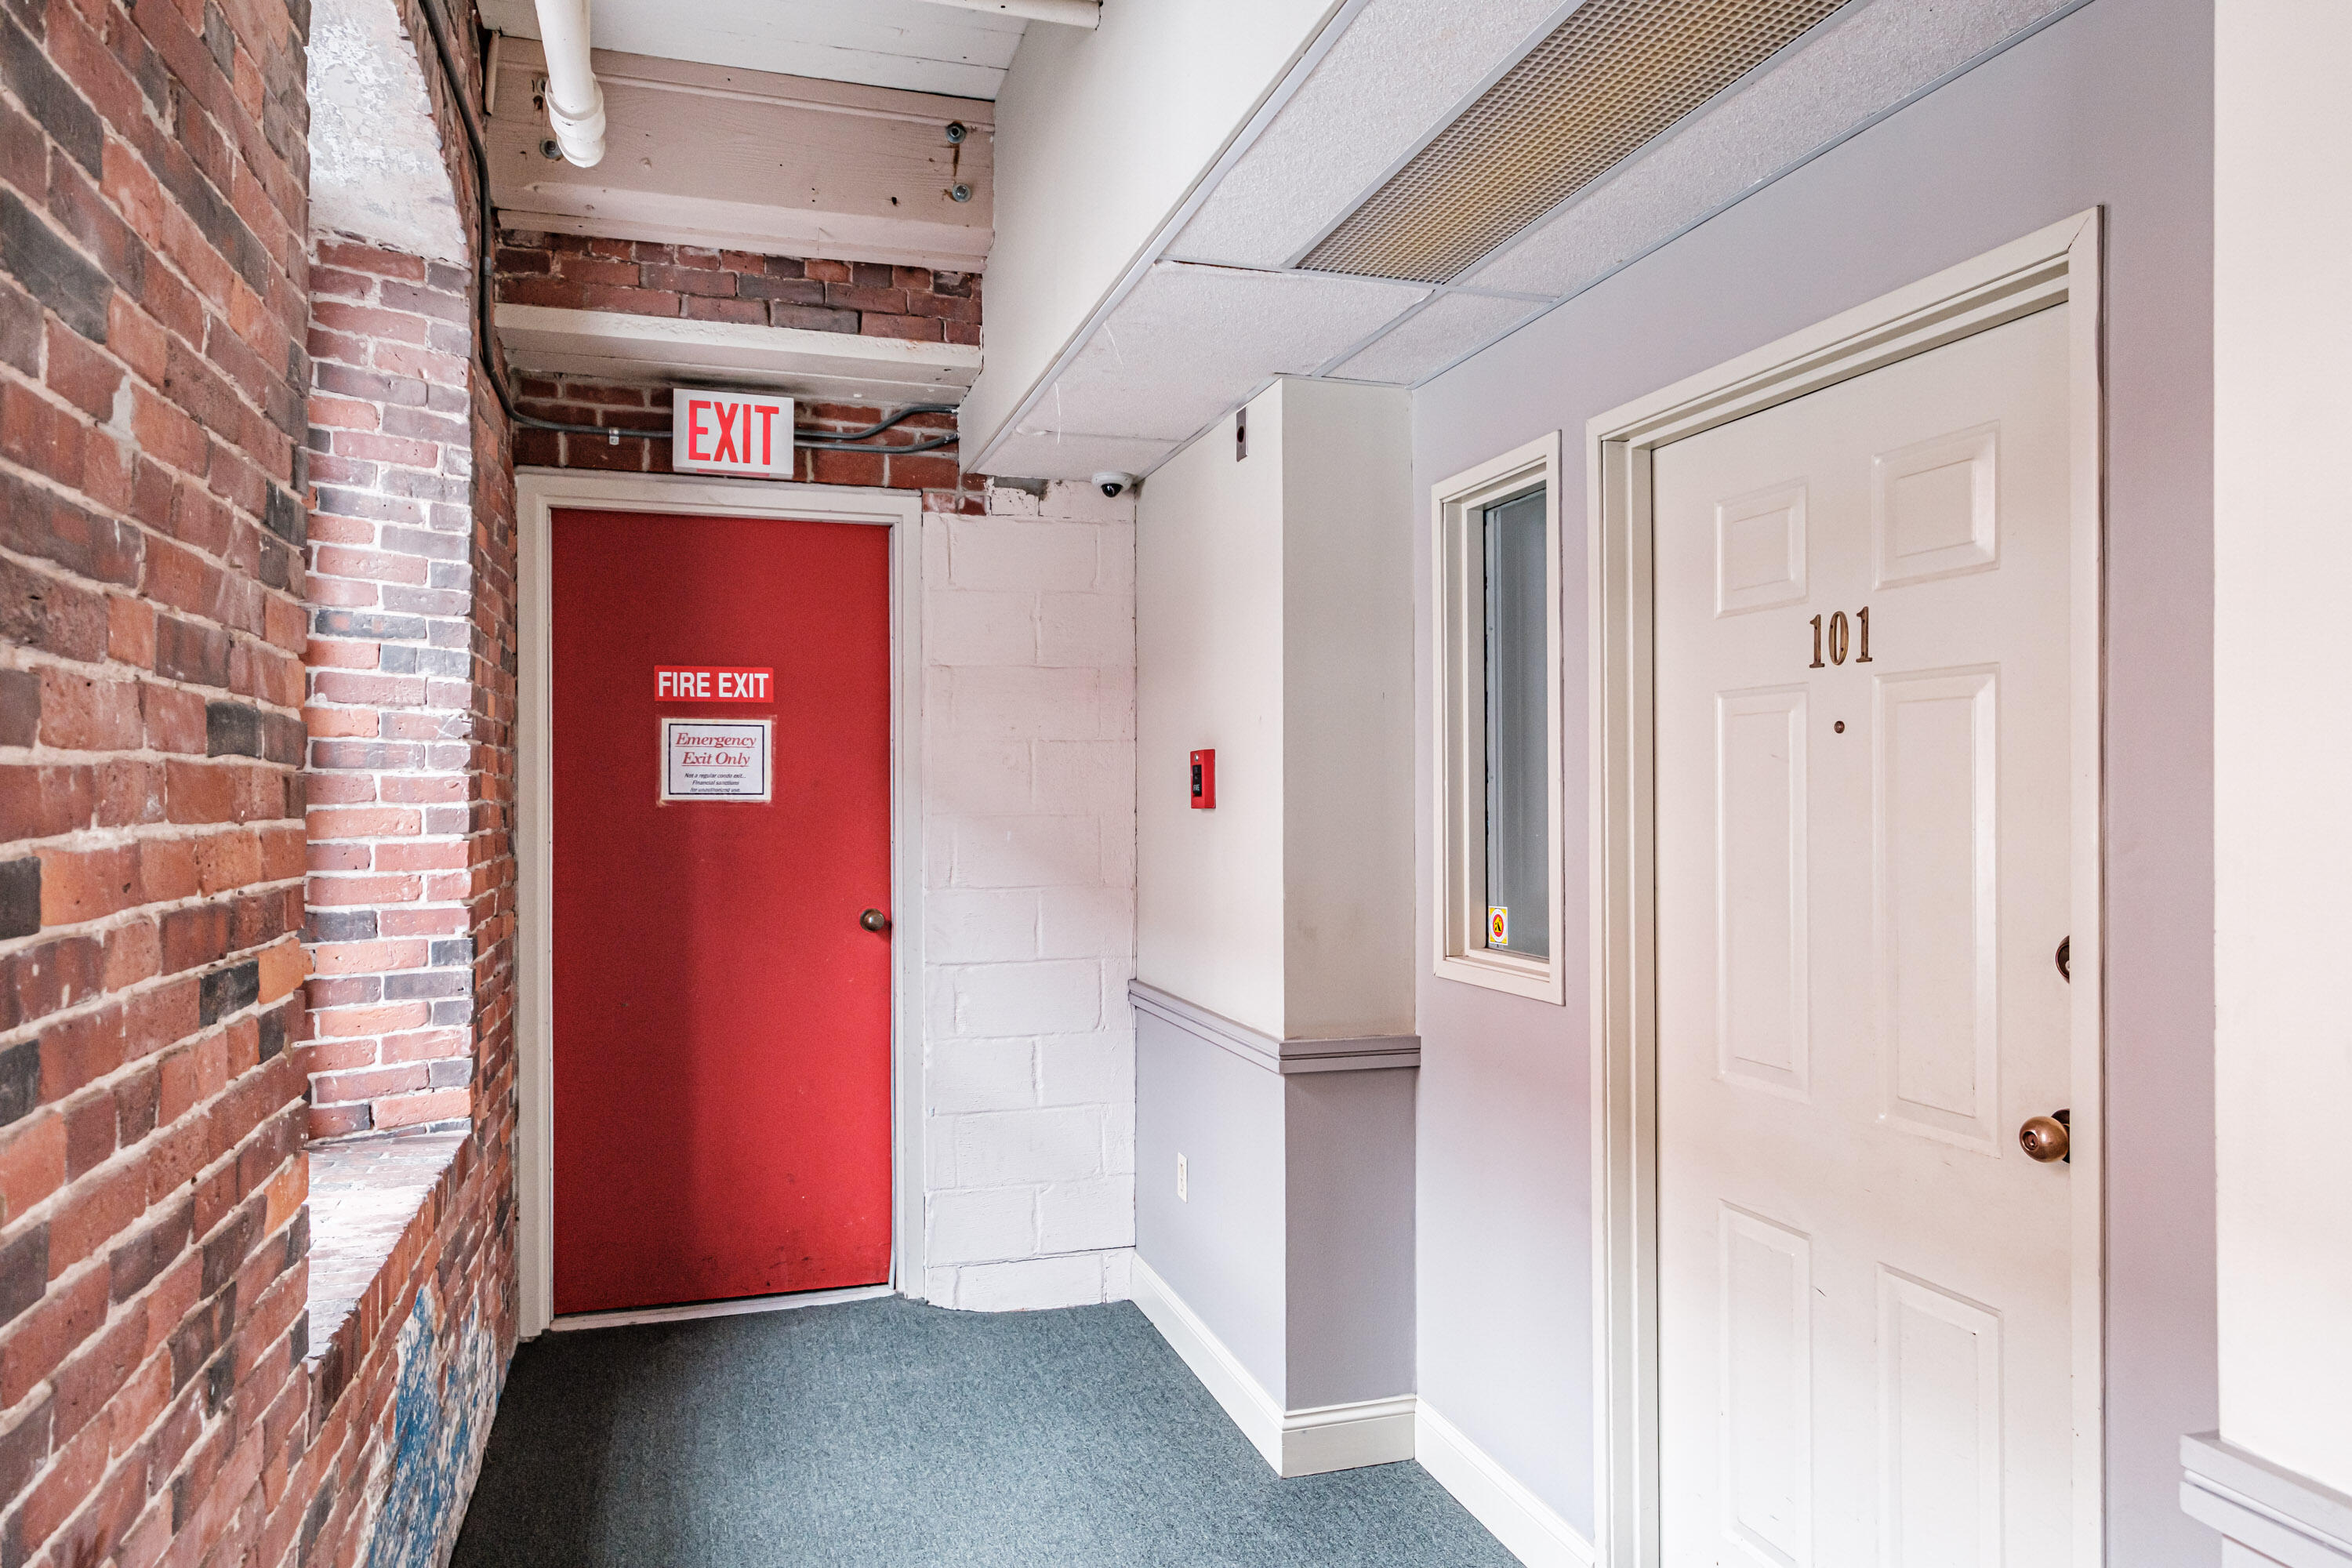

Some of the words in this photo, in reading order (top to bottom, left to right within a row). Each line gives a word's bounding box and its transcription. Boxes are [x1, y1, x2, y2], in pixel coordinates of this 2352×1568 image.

[688, 400, 779, 466] EXIT
[1809, 606, 1873, 669] 101
[658, 671, 710, 697] FIRE
[718, 672, 769, 698] EXIT
[675, 732, 757, 749] Emergency
[682, 751, 713, 765] Exit
[715, 751, 750, 767] Only
